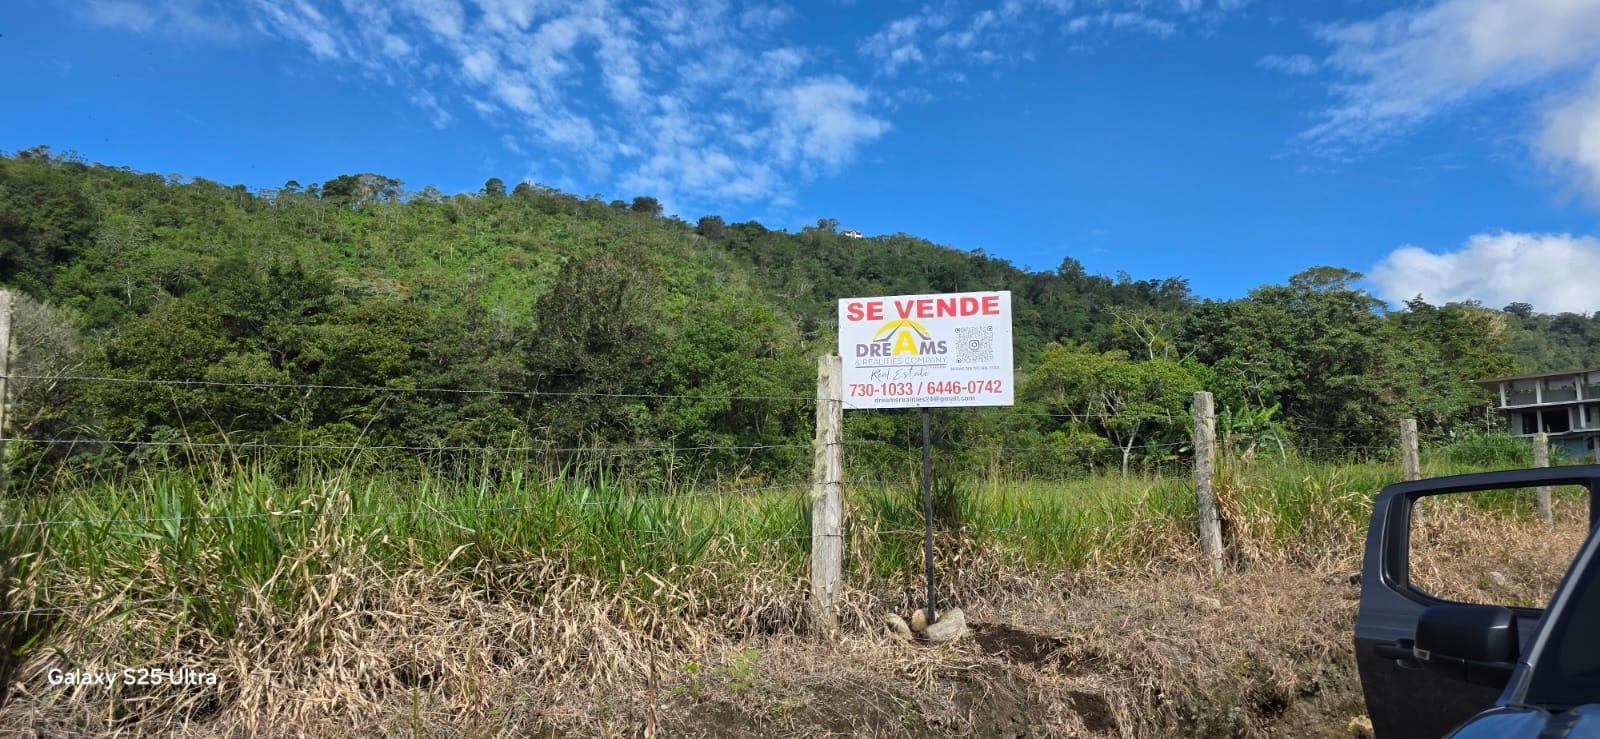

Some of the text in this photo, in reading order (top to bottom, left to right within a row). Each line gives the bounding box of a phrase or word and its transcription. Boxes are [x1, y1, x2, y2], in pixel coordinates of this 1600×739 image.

[847, 296, 1000, 321] SE VENDE
[856, 331, 948, 357] DREAMS
[862, 358, 903, 366] REALITIES
[905, 357, 946, 365] COMPANY
[870, 366, 928, 381] Real Estate
[849, 380, 1002, 397] 730-1033 / 6446-0742
